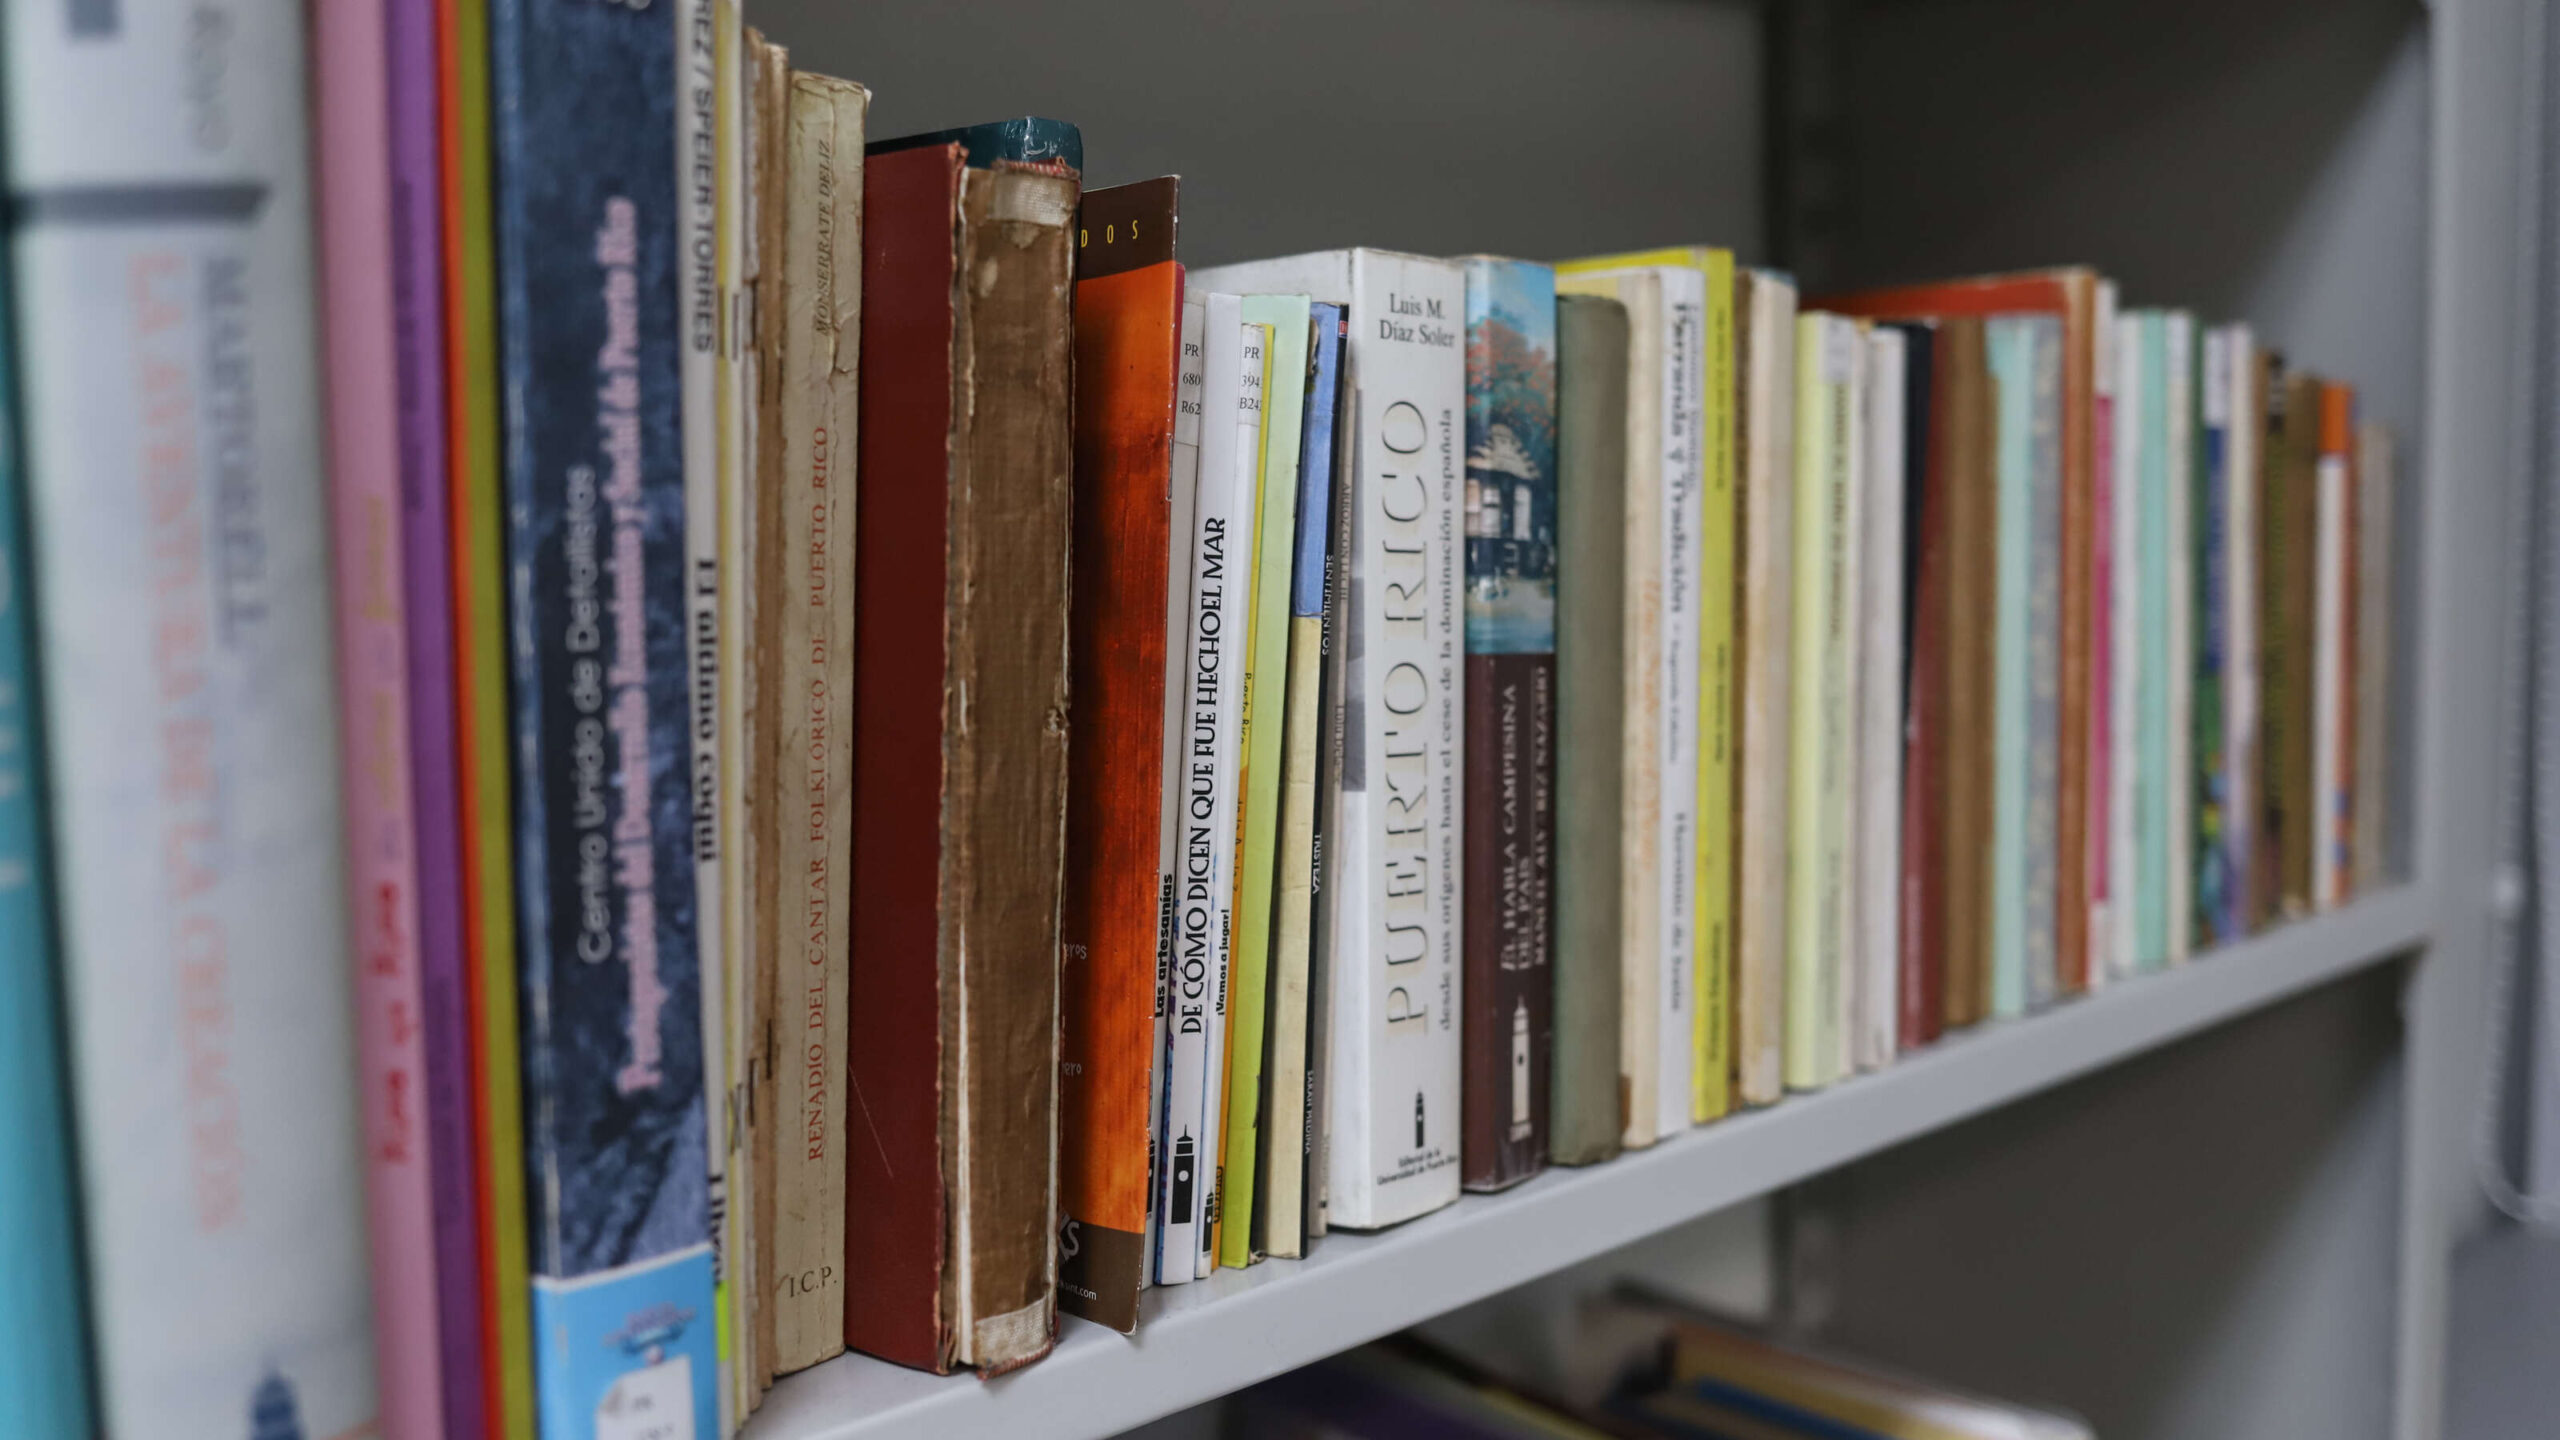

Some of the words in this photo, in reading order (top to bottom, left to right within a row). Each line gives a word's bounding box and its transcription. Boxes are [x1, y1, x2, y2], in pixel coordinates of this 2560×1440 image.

[814, 138, 832, 198] DELIZ
[814, 202, 832, 338] MONSERRATE
[1380, 319, 1414, 343] Díaz
[1419, 323, 1455, 349] Soler
[1389, 292, 1422, 317] Luis
[1426, 297, 1446, 320] M.
[1185, 343, 1199, 357] PR
[1243, 346, 1260, 359] PR
[811, 427, 828, 490] RICO
[1437, 409, 1455, 503] española
[1202, 517, 1226, 580] MAR
[1381, 400, 1429, 641] RICO
[565, 465, 602, 653] Detallistas
[810, 504, 827, 608] PUERTO
[1438, 510, 1452, 634] dominación
[810, 634, 826, 665] DE
[1196, 585, 1222, 707] HECHOEL
[1439, 641, 1452, 660] la
[570, 658, 604, 714] de
[1439, 667, 1452, 692] de
[1194, 711, 1217, 757] FUE
[1440, 699, 1452, 743] cese
[573, 719, 608, 830] Unido
[806, 679, 826, 842] FOLKLÓRICO
[1439, 749, 1452, 768] el
[1501, 684, 1517, 836] CAMPESINA
[1190, 761, 1215, 820] QUE
[1439, 775, 1453, 830] hasta
[1187, 826, 1211, 902] DICEN
[1312, 832, 1323, 896] TRISTEZA
[1382, 662, 1429, 1037] PUERTO
[577, 832, 612, 964] Centro
[807, 859, 824, 966] CANTAR
[1502, 842, 1517, 929] HABLA
[1157, 873, 1173, 981] artesanías
[1179, 906, 1208, 1000] CÓMO
[1218, 908, 1230, 950] jugar!
[1441, 929, 1452, 965] sus
[1516, 918, 1532, 970] DEL
[1219, 953, 1228, 963] a
[808, 978, 824, 1030] DEL
[1153, 985, 1166, 1019] Las
[1181, 1003, 1202, 1035] DE
[1215, 964, 1227, 1017] ¡Vamos
[1439, 971, 1453, 1031] desde
[789, 1265, 837, 1299] I.C.P.
